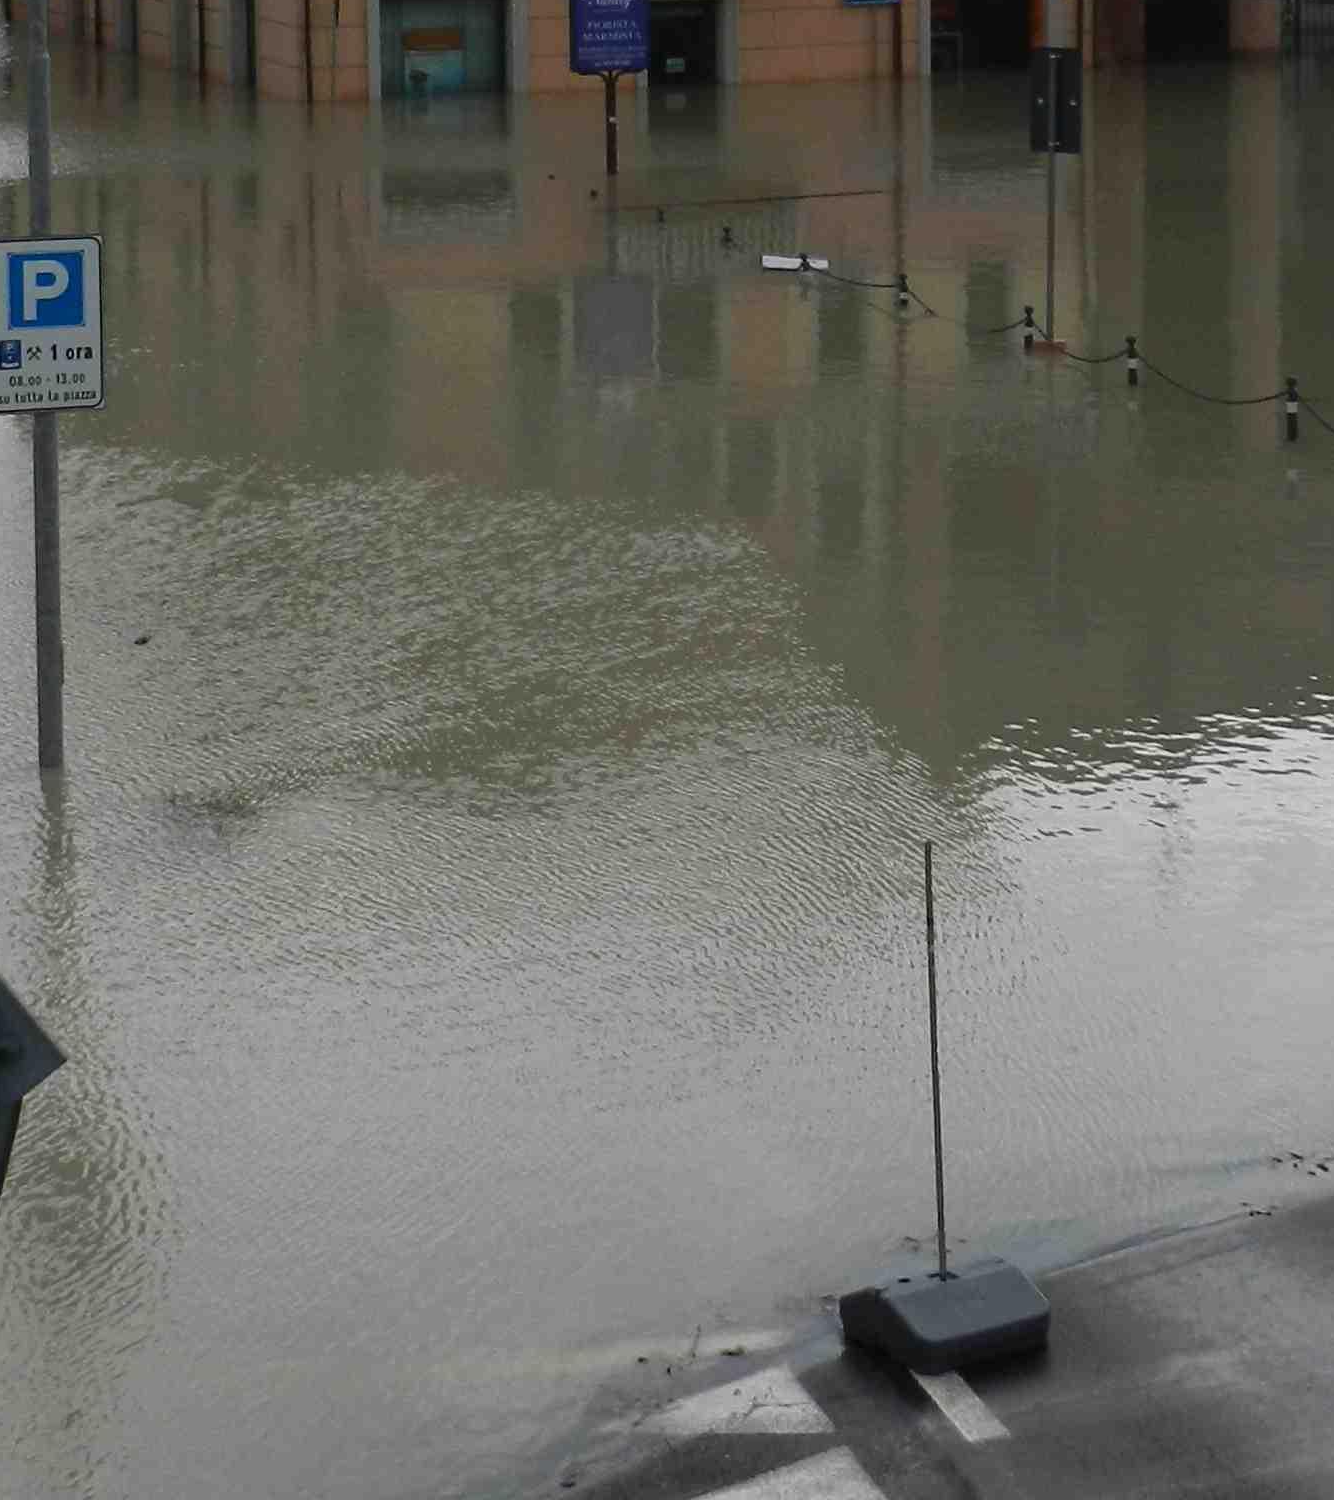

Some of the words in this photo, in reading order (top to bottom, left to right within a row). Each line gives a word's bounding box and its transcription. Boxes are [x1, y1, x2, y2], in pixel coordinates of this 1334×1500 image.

[23, 259, 69, 321] P
[50, 344, 58, 361] 1
[65, 346, 93, 360] ora
[9, 375, 42, 387] 08.00
[14, 391, 44, 404] tutta
[48, 390, 59, 402] la
[63, 389, 97, 403] piazza
